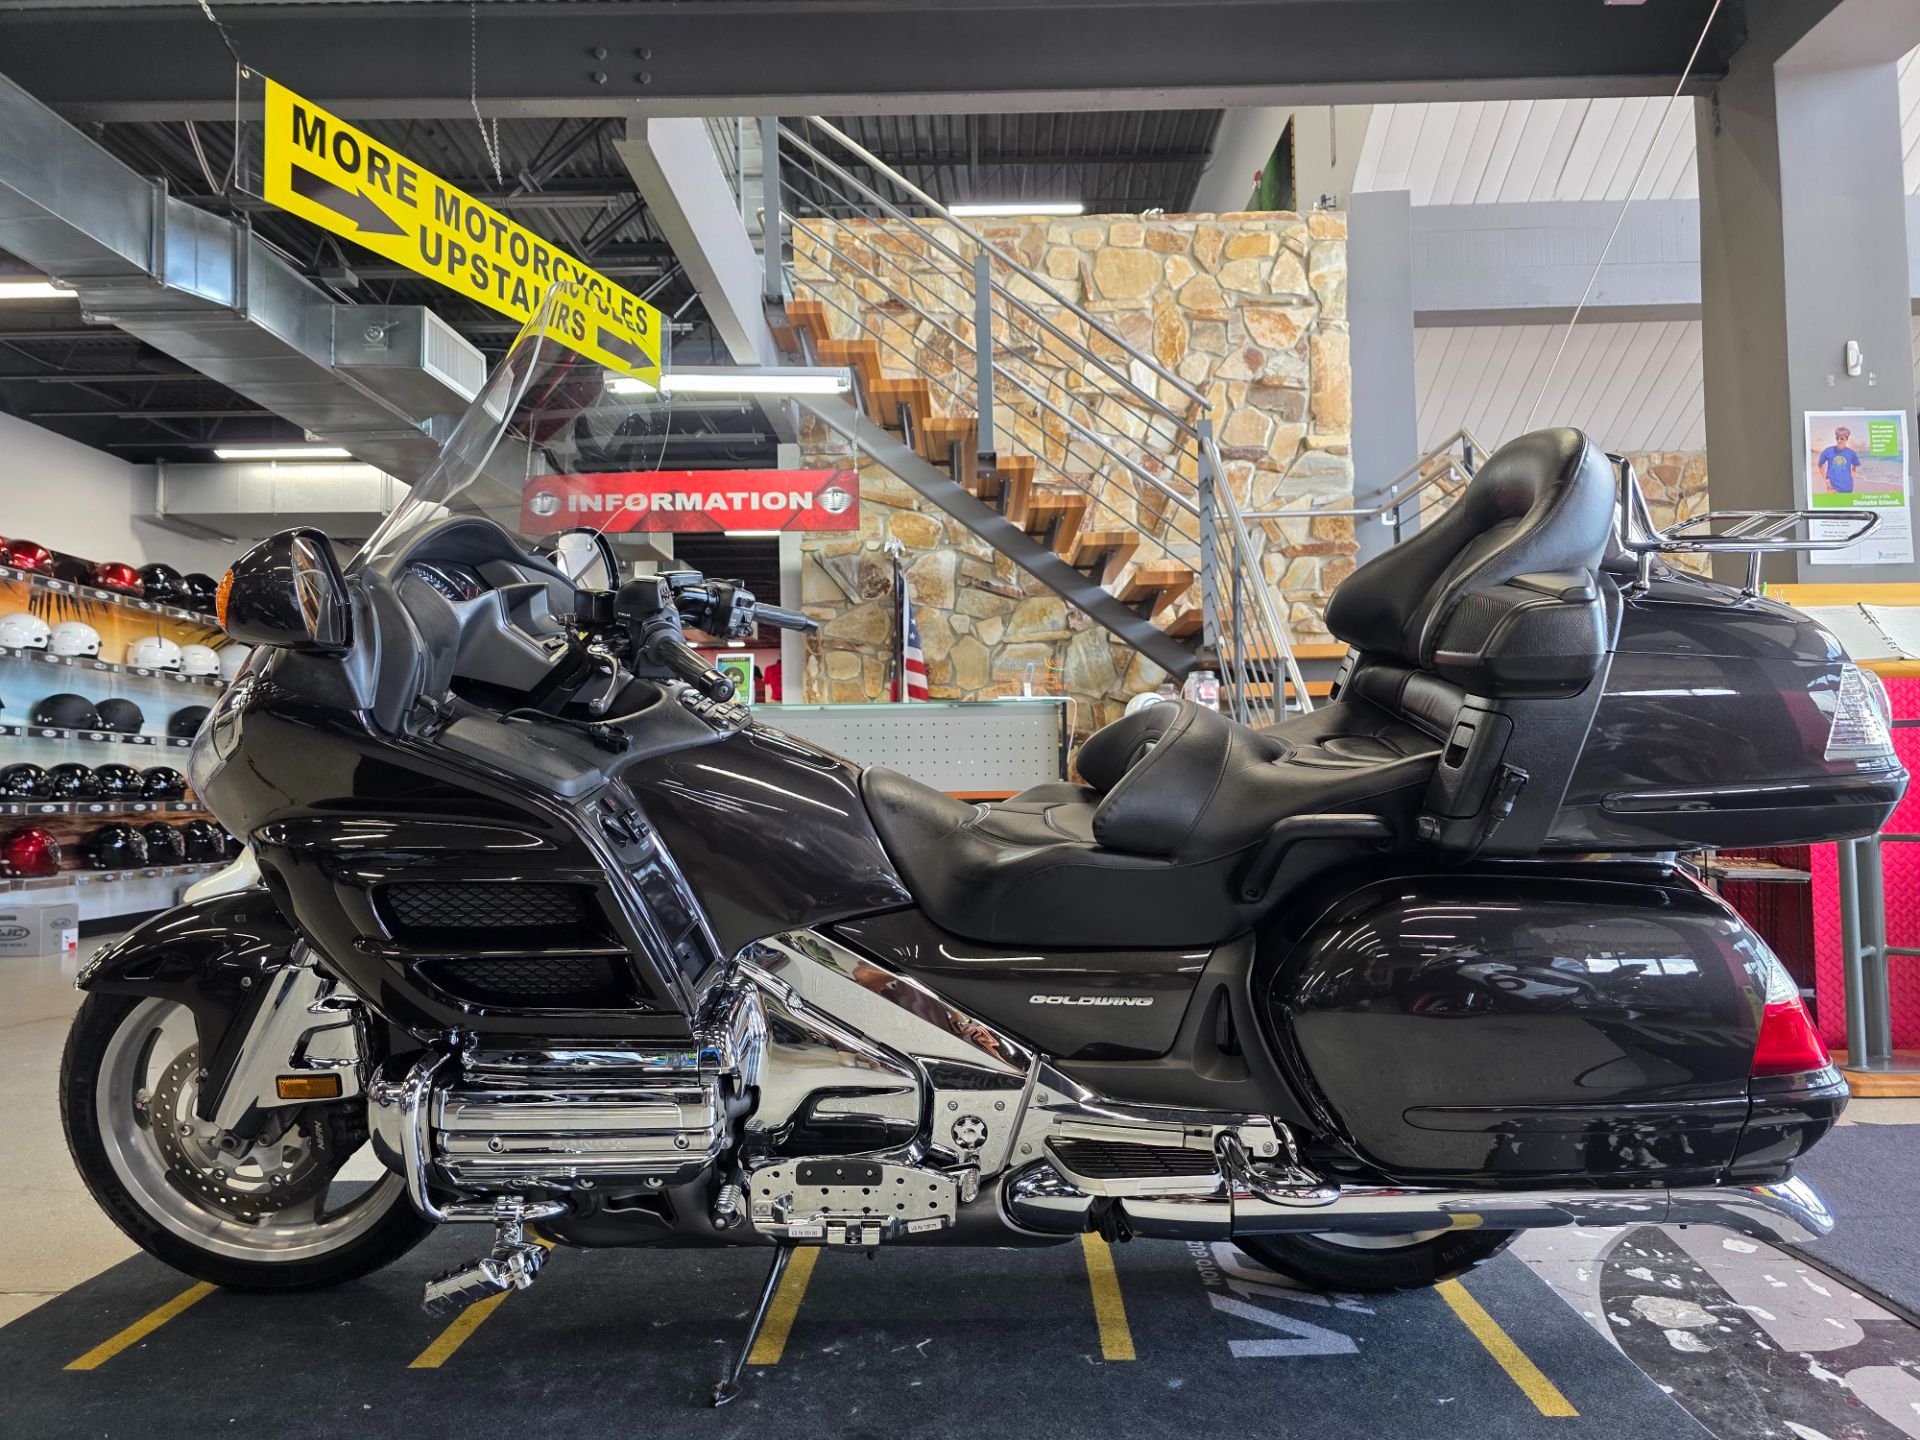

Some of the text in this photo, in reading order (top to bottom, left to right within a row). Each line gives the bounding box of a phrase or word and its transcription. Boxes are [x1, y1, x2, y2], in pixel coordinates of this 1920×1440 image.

[292, 103, 648, 335] MORE MOTORCYCLES
[419, 224, 586, 342] UPSTAIRS
[568, 491, 813, 513] INFORMATION
